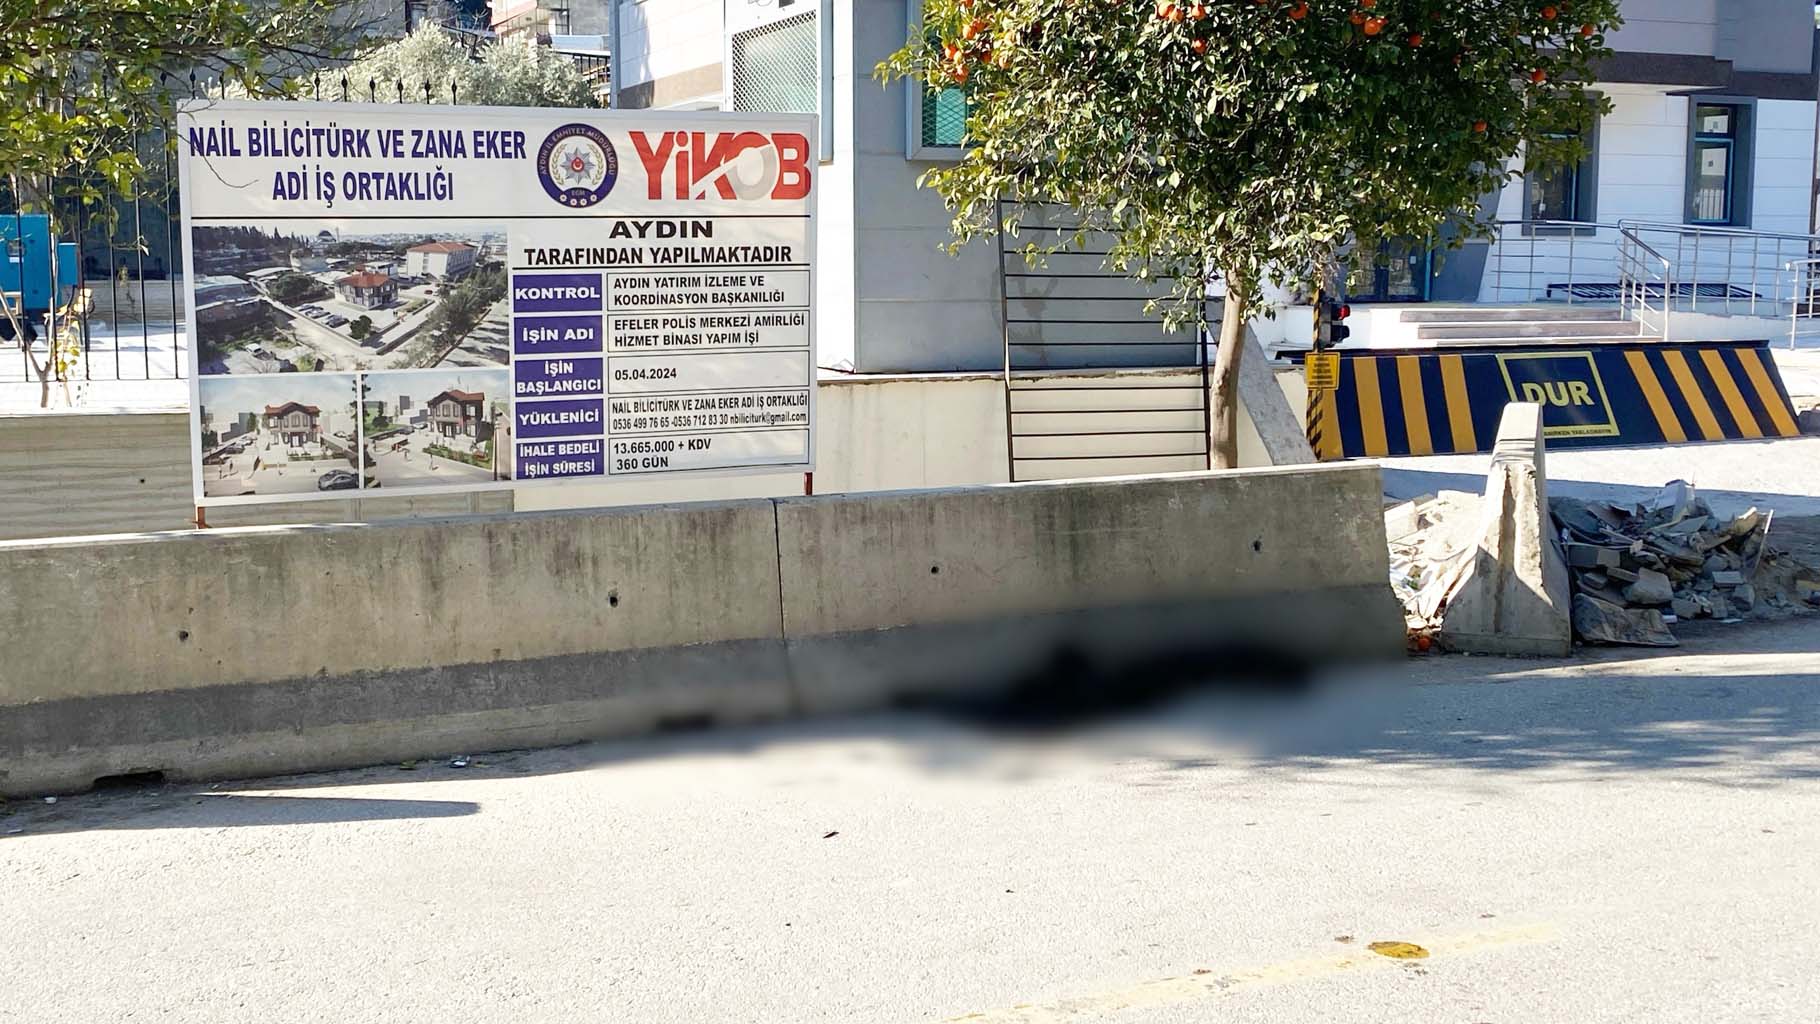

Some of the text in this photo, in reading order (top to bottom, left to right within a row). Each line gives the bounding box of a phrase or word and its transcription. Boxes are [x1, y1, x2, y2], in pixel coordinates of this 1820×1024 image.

[189, 120, 527, 159] NAİL BİLİCİTÜRK VE ZANA EKER
[272, 164, 453, 208] ADİ İŞ ORTAKLIĞI
[609, 221, 713, 239] AYDIN
[524, 246, 792, 265] TARAFINDAN YAPILMAKTADIR
[614, 274, 764, 289] AYDIN YATIRIM İZLEME VE
[515, 287, 600, 300] KONTROL
[614, 291, 784, 306] KOORDİNASYON BAŞKANILIĞI
[614, 313, 805, 330] EFELER POLİS MERKEZİ AMİRLİĞİ
[523, 327, 594, 344] İŞİN ADI
[615, 329, 759, 347] HİZMET BİNASI YAPIM İŞİ
[544, 360, 573, 377] İŞİN
[615, 367, 677, 381] 05.04.2024
[517, 379, 600, 395] BAŞLANGICI
[1522, 381, 1595, 407] DUR
[682, 399, 693, 410] VE
[695, 398, 716, 410] ZANA
[718, 397, 739, 409] EKER
[766, 392, 808, 407] ORTAKLIĞI
[520, 408, 599, 425] YÜKLENİCİ
[613, 418, 632, 430] 0536
[634, 417, 647, 429] 499
[650, 417, 658, 428] 76
[660, 416, 670, 428] 65
[693, 414, 707, 426] 712
[709, 414, 717, 425] 83
[719, 414, 728, 425] 30
[520, 440, 599, 458] İHALE BEDELİ
[614, 440, 674, 455] 13.665.000
[688, 438, 711, 451] KDV
[525, 459, 595, 478] İŞİN SÜRESİ
[616, 455, 669, 470] 360 GÜN
